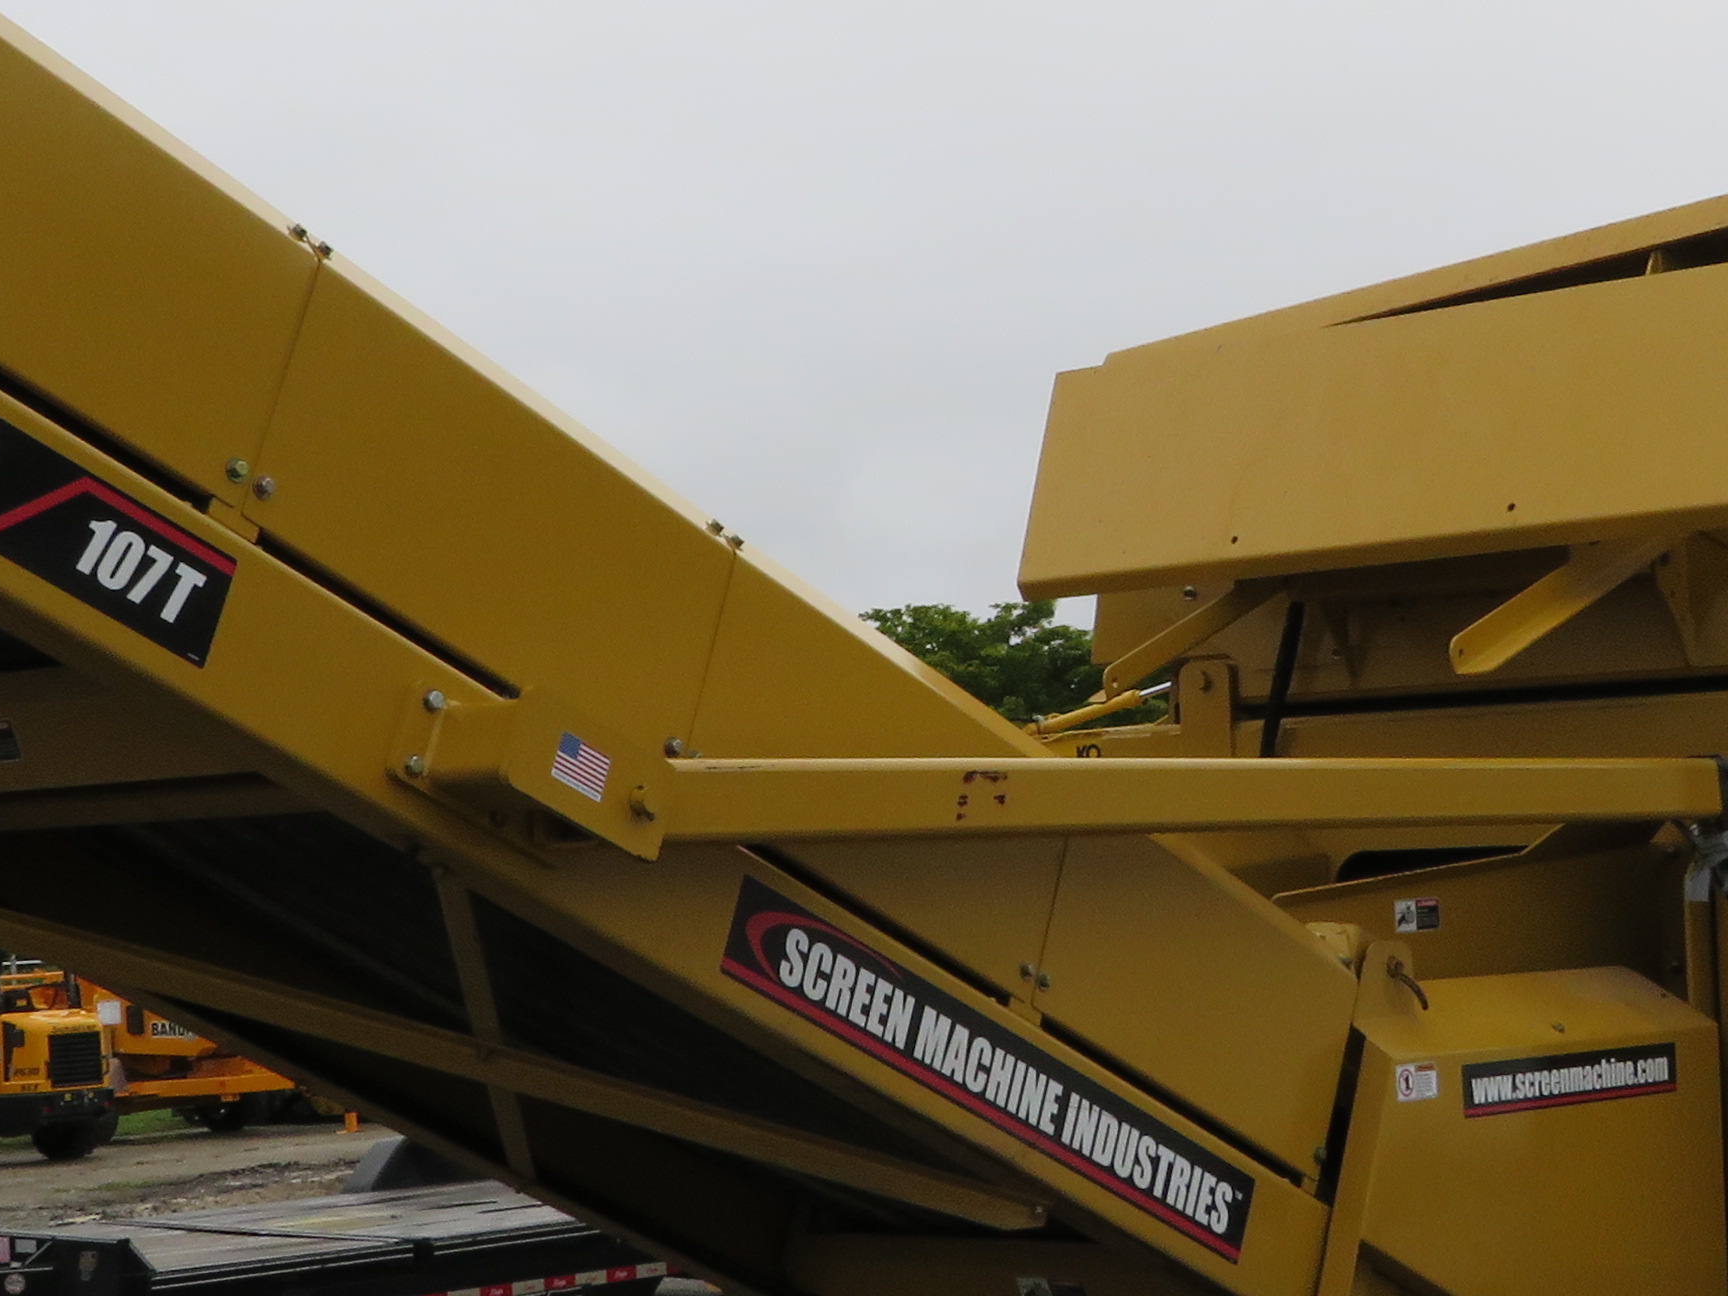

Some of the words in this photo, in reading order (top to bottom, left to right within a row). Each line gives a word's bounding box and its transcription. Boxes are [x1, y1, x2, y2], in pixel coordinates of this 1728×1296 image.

[75, 519, 208, 624] 107T
[779, 928, 917, 1051] SCREEN
[913, 1004, 1064, 1137] MACHINE
[1061, 1091, 1235, 1236] INDUSTRIES
[1472, 1056, 1669, 1105] www.screenmachine.com
